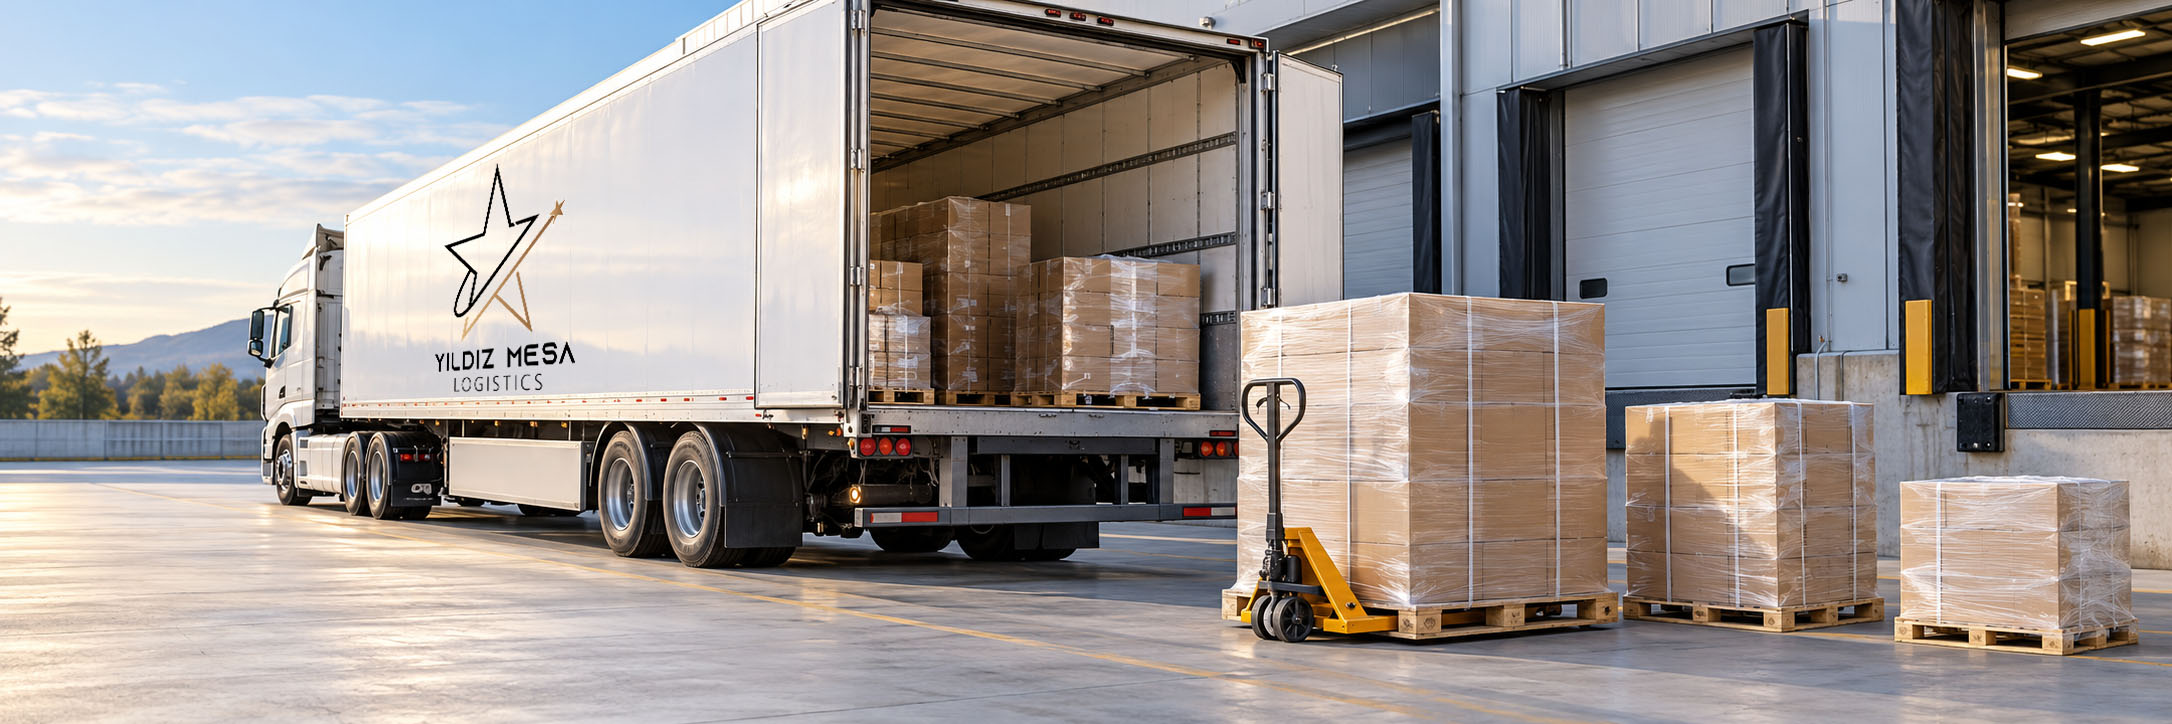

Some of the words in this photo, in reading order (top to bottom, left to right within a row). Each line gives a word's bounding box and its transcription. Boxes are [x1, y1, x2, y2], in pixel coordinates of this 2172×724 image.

[435, 348, 494, 372] YILDIZ
[507, 341, 575, 367] MESA
[453, 373, 543, 392] LOGISTICS
